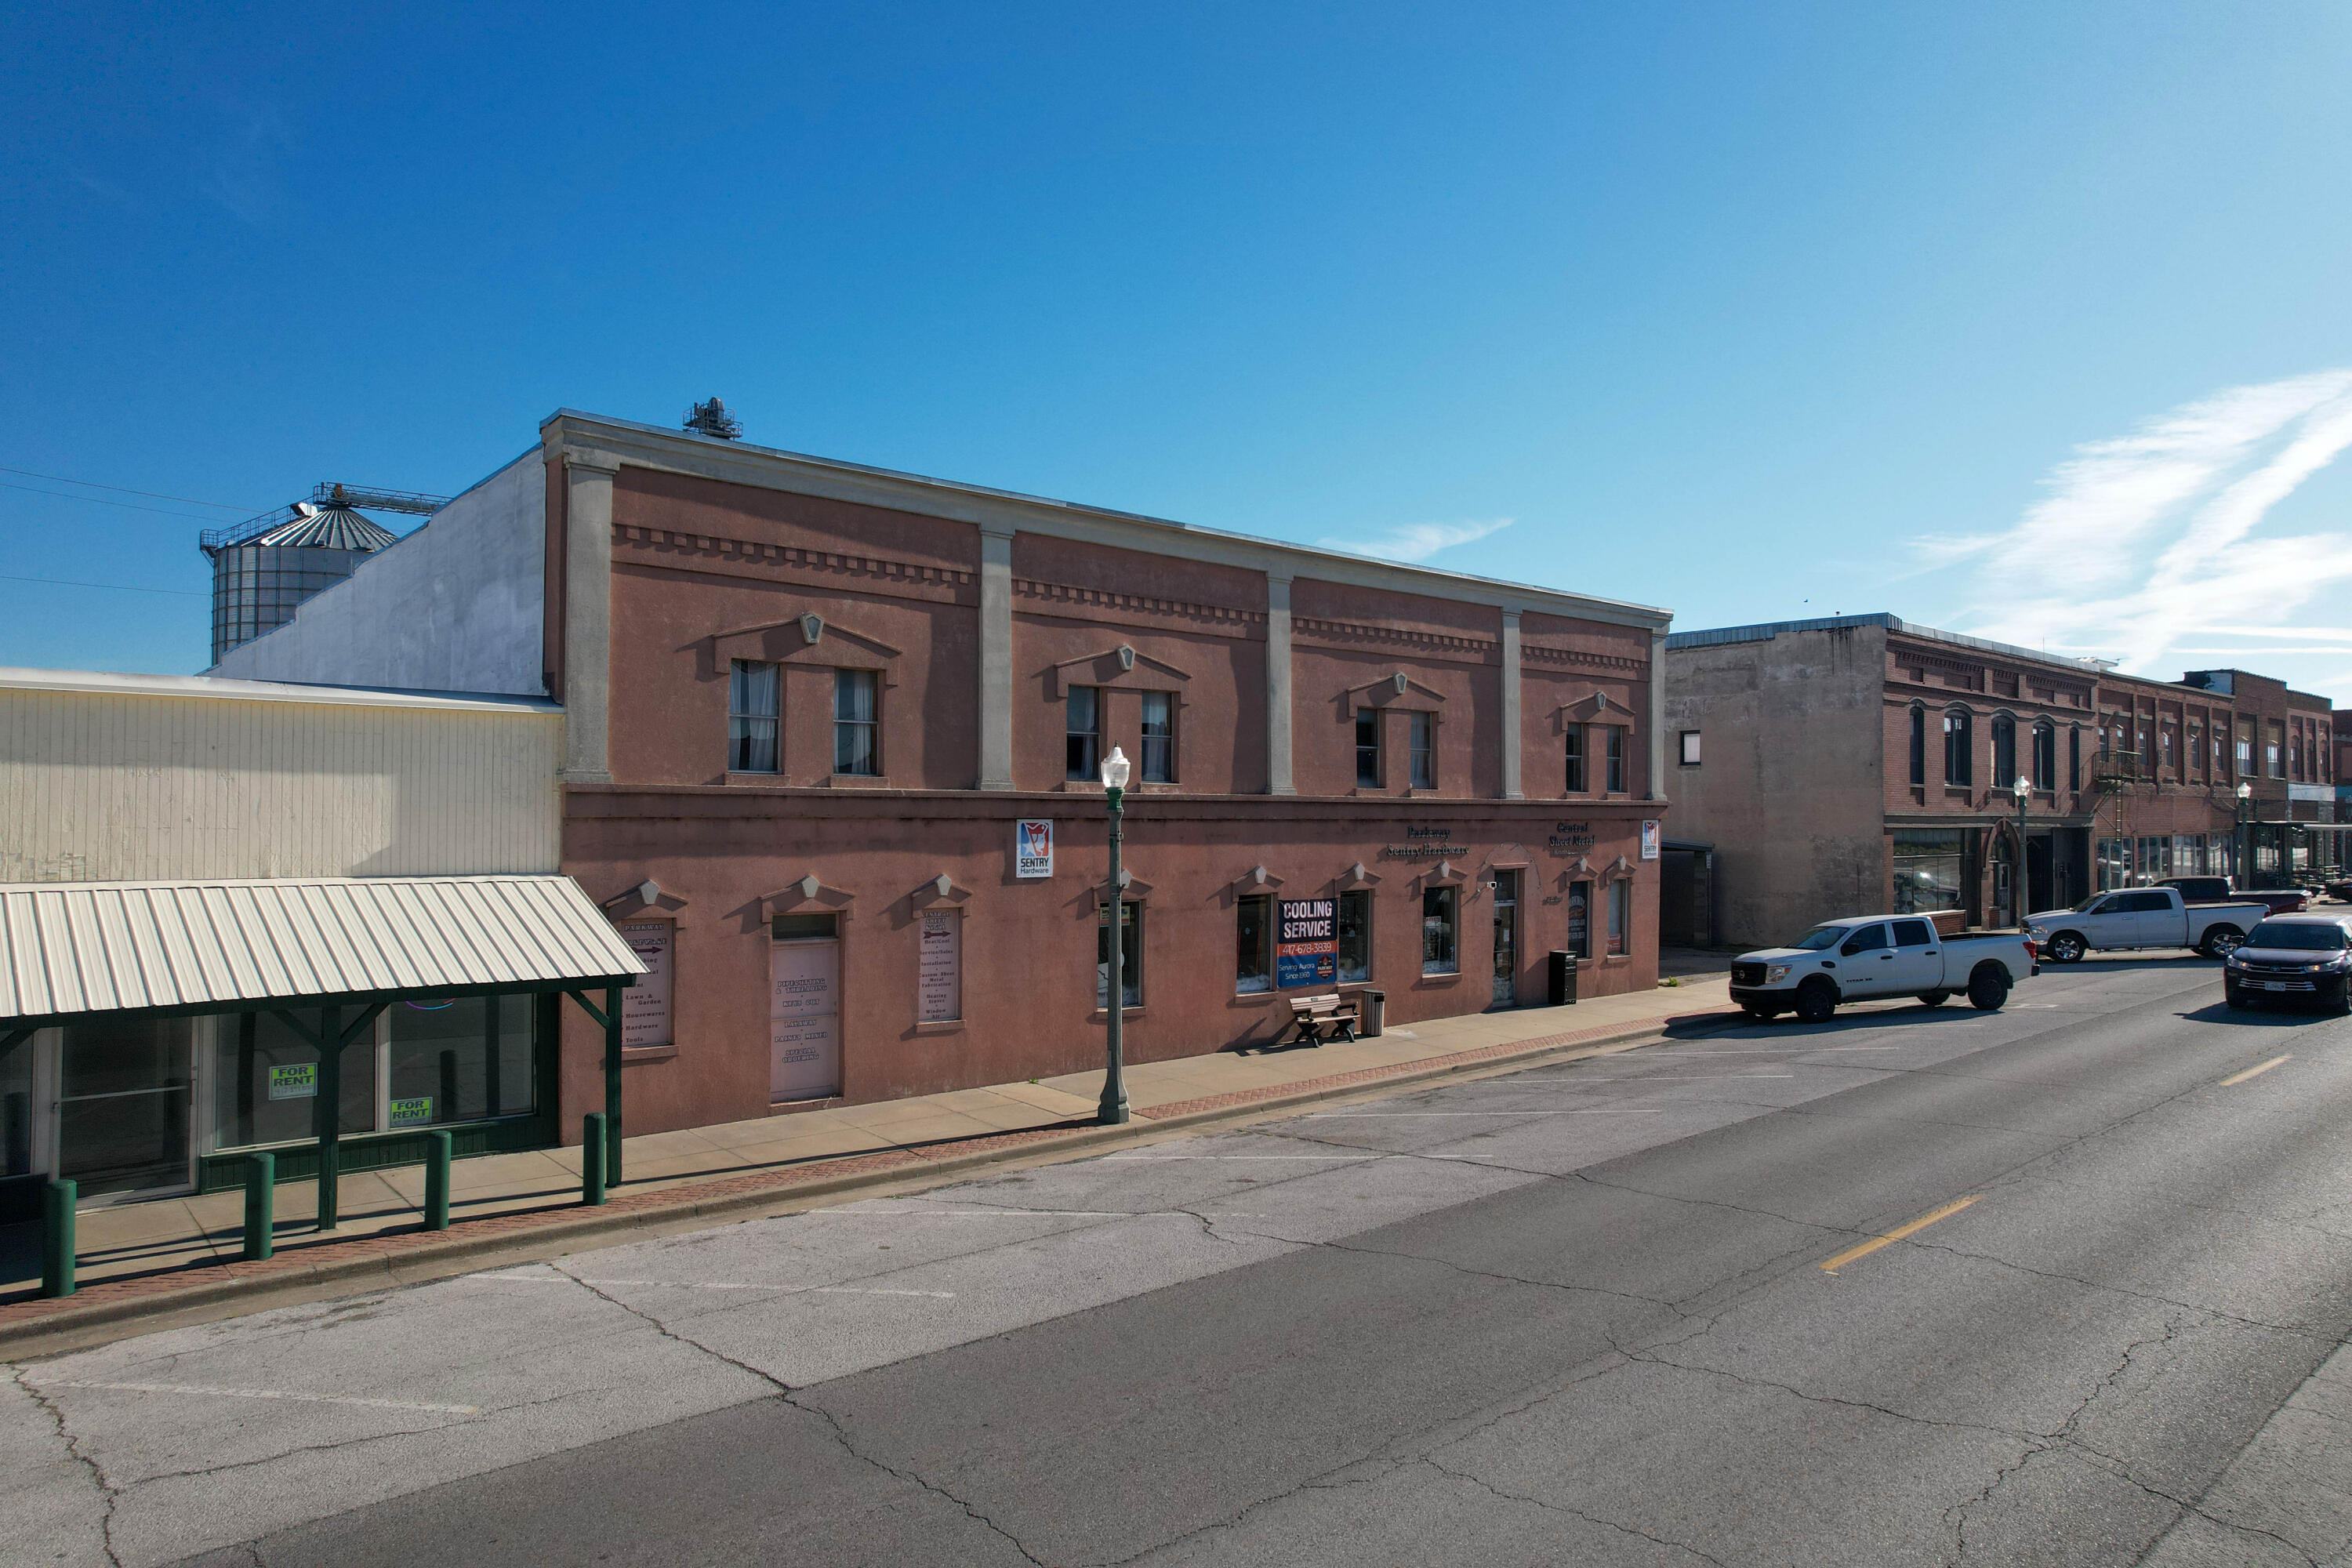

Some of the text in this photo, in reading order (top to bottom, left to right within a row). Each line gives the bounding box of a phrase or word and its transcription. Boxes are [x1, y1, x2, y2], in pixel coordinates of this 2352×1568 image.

[1407, 826, 1450, 840] Parkway
[1556, 822, 1588, 833] Central
[1549, 835, 1595, 846] Sheet Metal
[1387, 843, 1470, 859] Sentry Hardware
[1021, 858, 1049, 867] SENTRY
[1283, 901, 1333, 919] COOLING
[625, 924, 665, 932] PARKWAY
[1283, 920, 1331, 939] SERVICE
[1283, 942, 1332, 954] 417-678-3839
[279, 1066, 308, 1076] FOR
[274, 1075, 314, 1087] RENT
[397, 1100, 424, 1110] FOR
[393, 1109, 429, 1119] RENT
